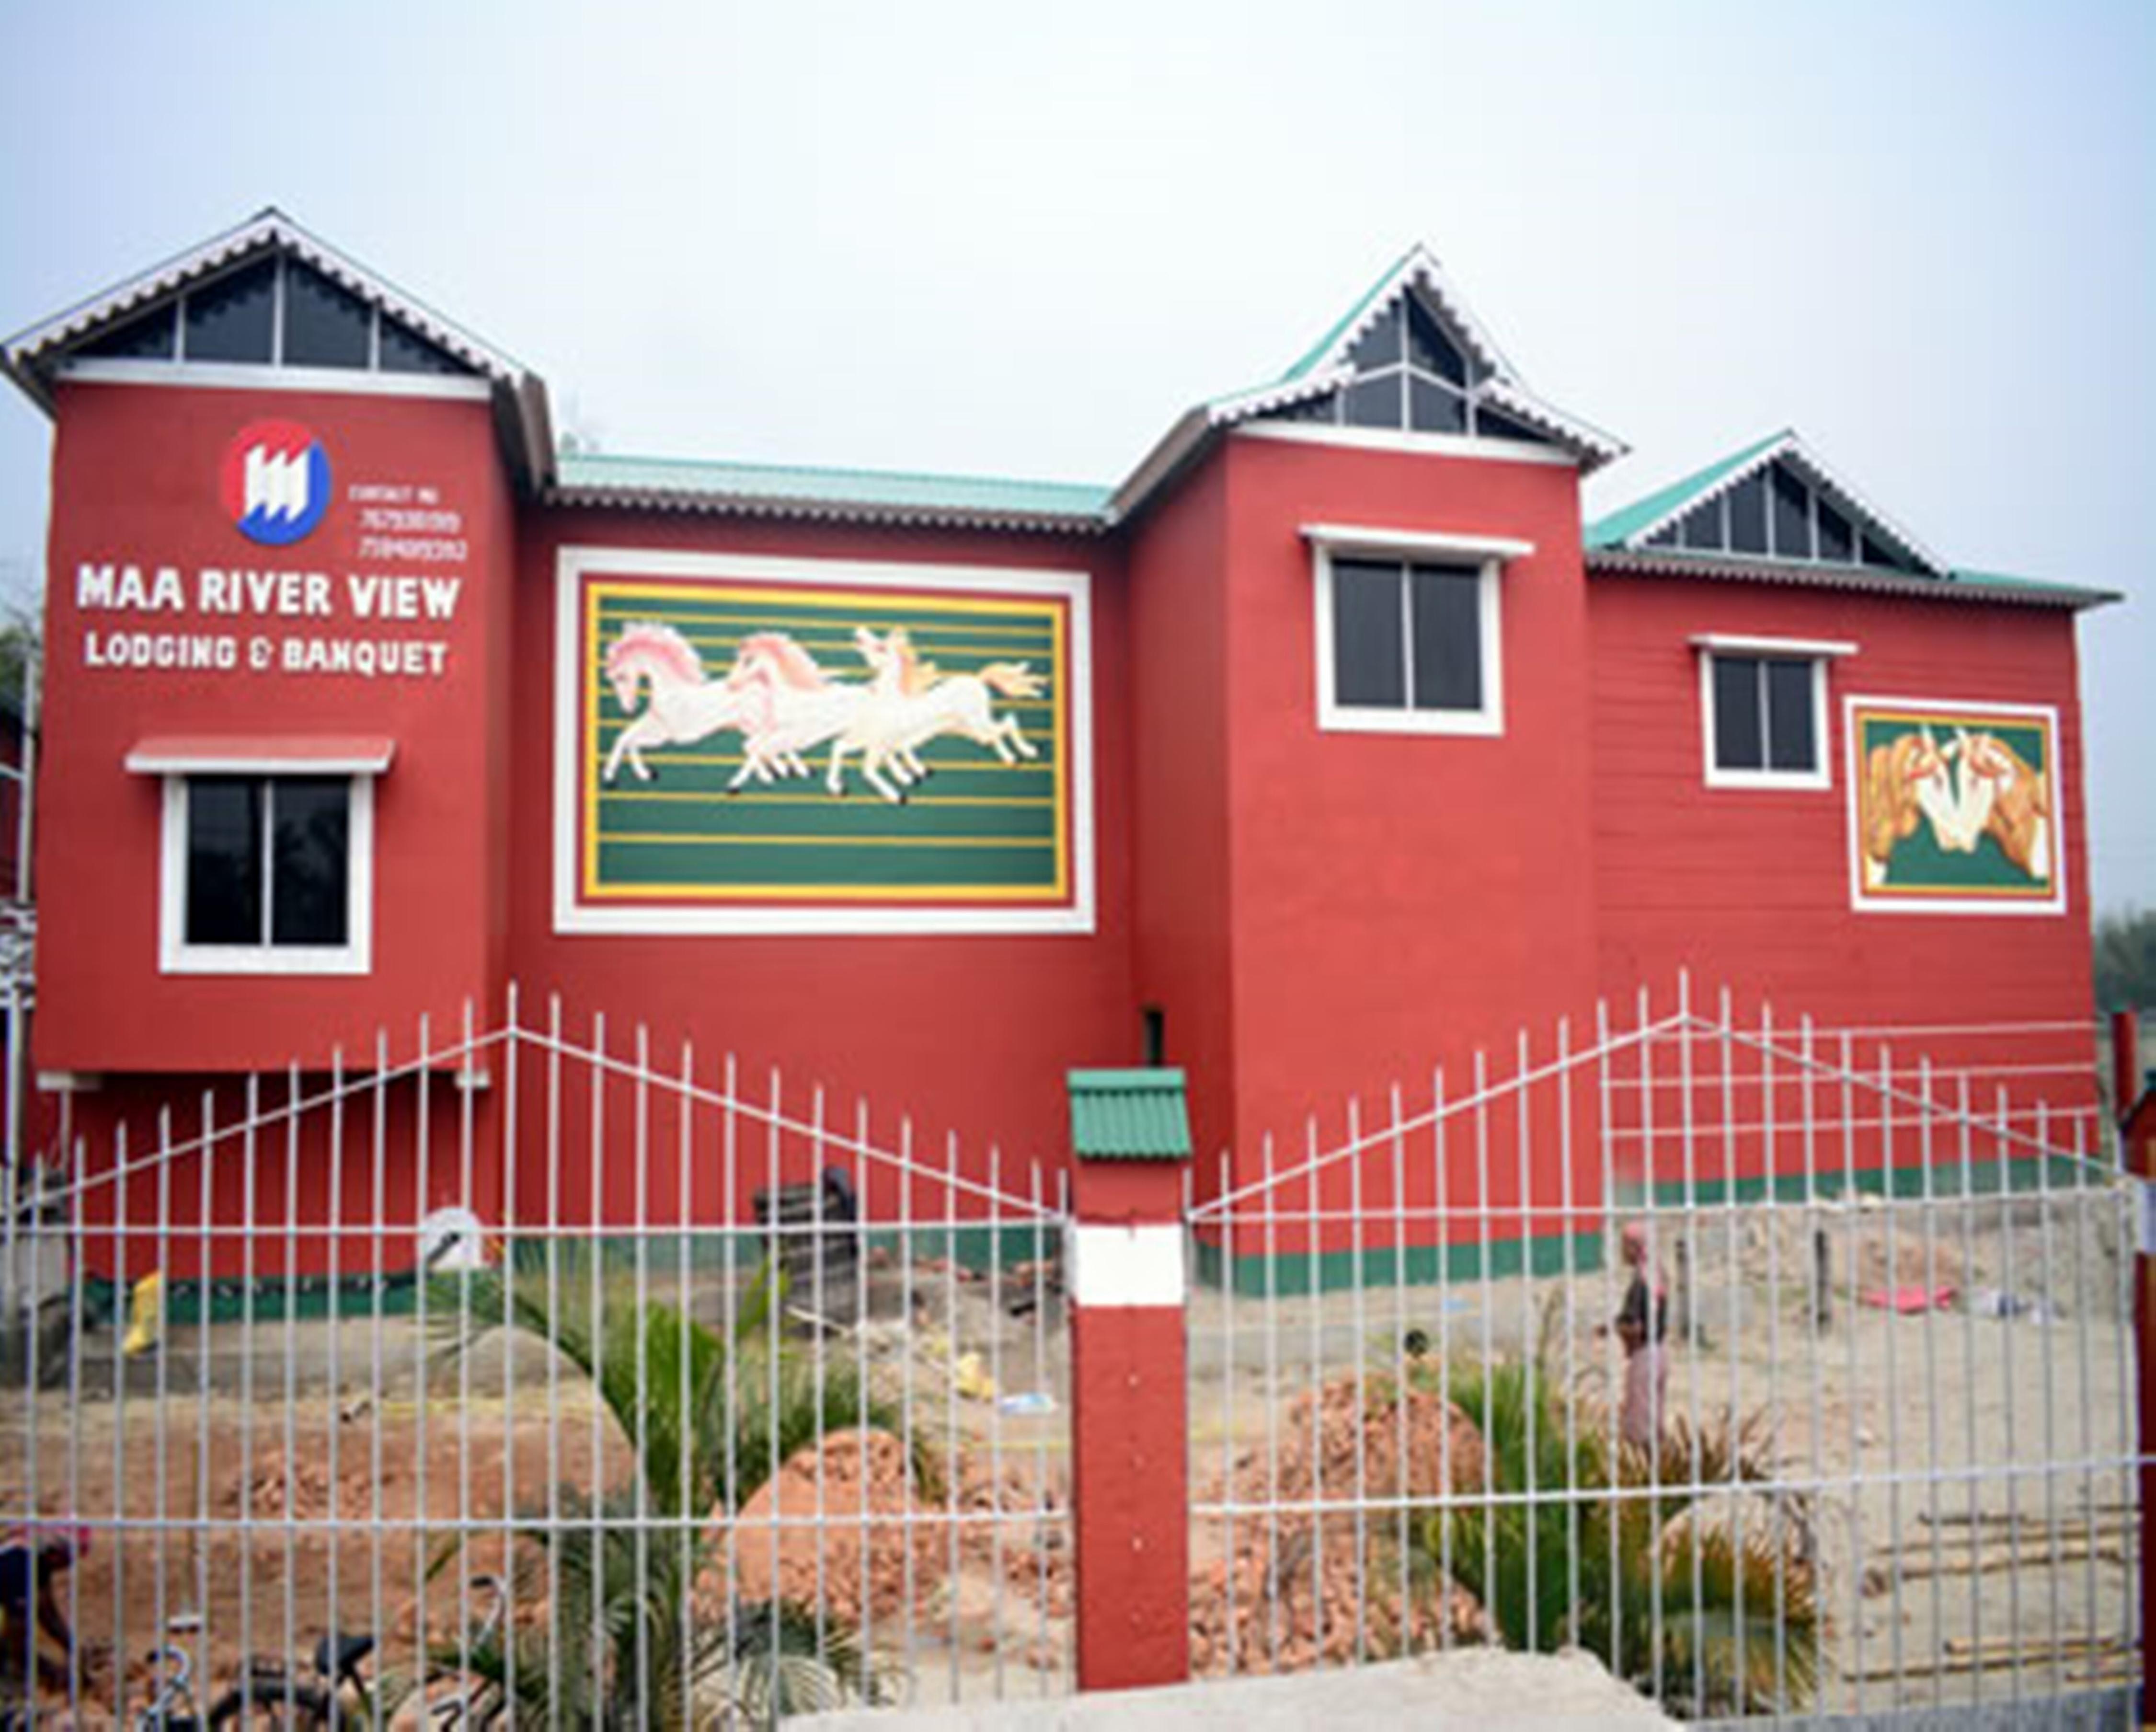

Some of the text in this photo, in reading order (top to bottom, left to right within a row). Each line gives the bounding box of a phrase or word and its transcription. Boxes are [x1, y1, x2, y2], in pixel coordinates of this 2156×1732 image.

[78, 565, 461, 619] MAA RIVER VIEW
[86, 633, 447, 675] LODGING & BANQUET
